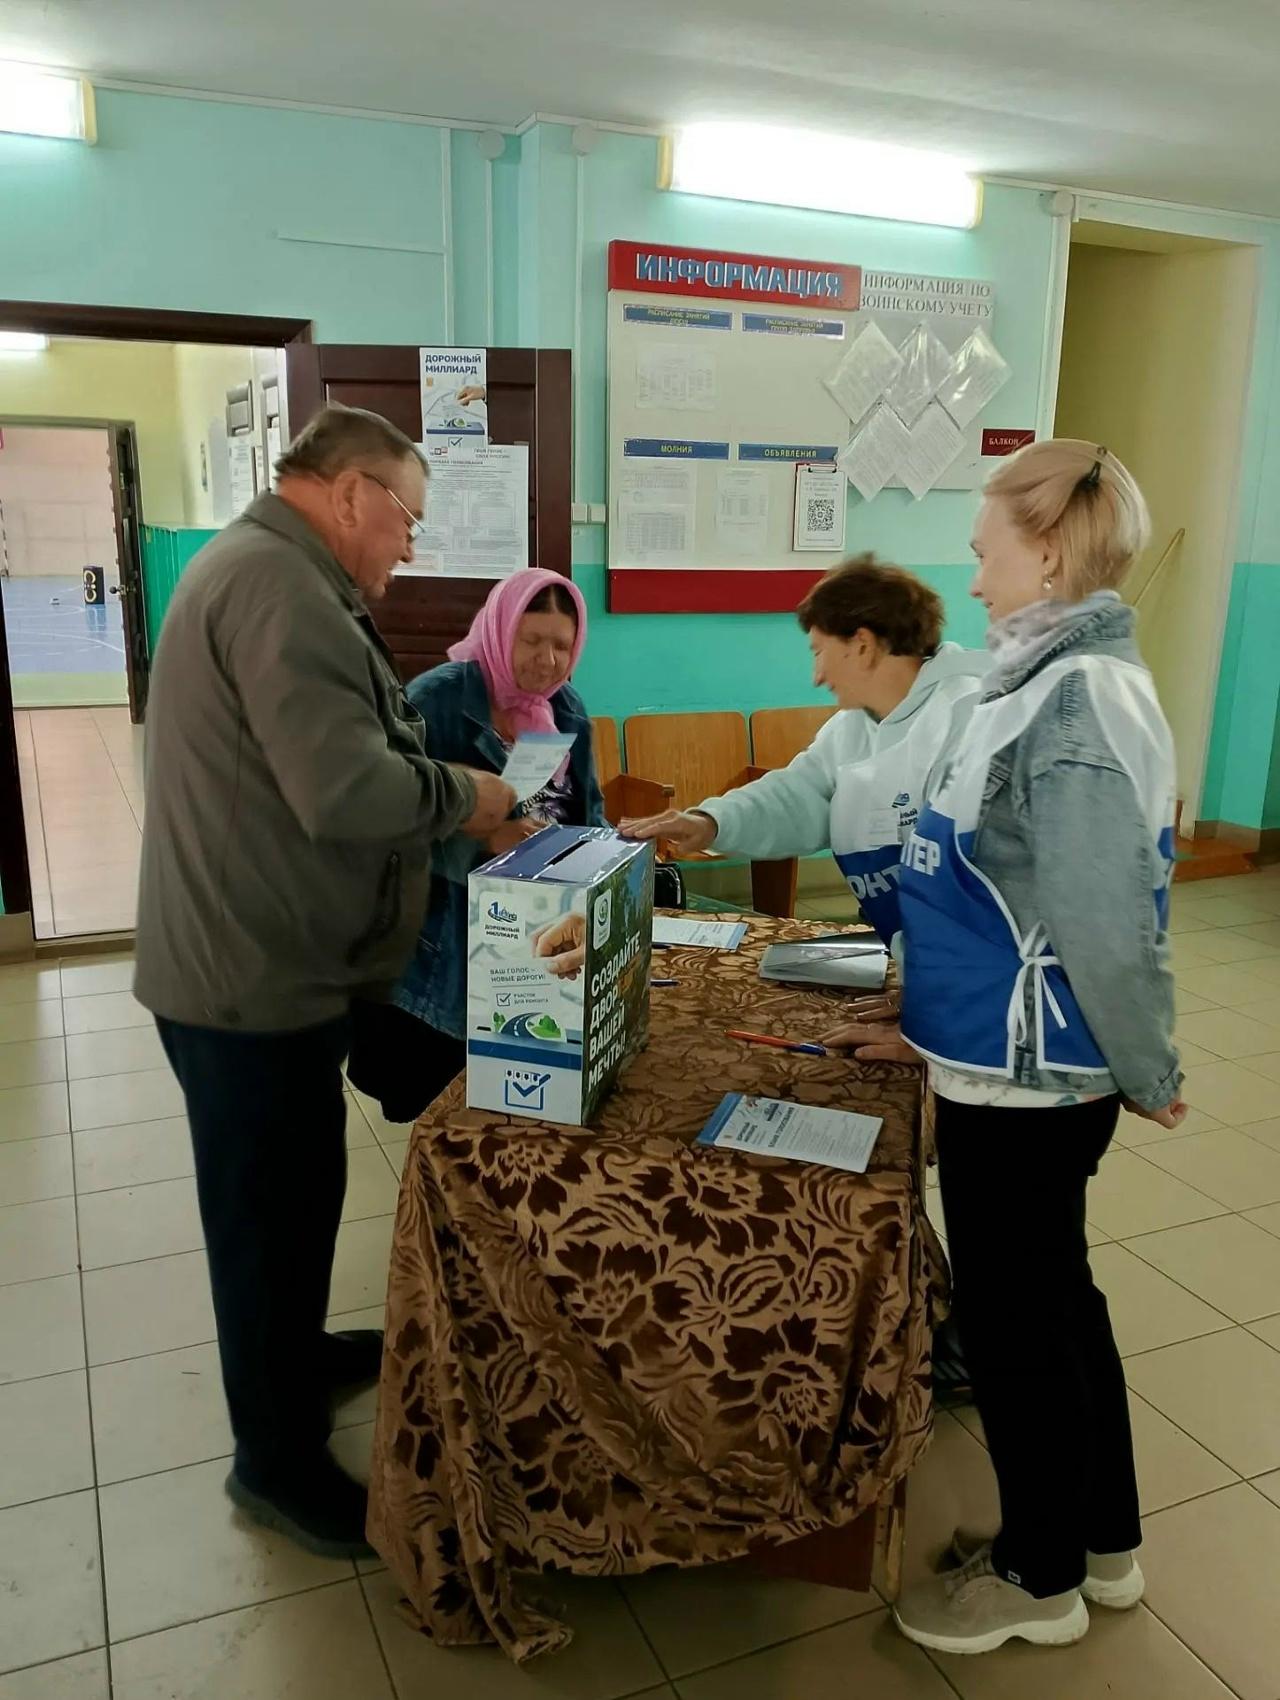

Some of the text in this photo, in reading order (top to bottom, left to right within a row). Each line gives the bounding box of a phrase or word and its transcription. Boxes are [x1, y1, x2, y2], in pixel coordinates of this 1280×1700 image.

[635, 253, 844, 297] ИНФОРМАЦИЯ
[864, 273, 991, 298] ИНФОРМАЦИЯ ПО
[950, 302, 993, 317] УЧЕТУ
[425, 354, 482, 364] ДОРОЖНЫЙ
[425, 365, 477, 375] МИЛЛИАРД
[989, 437, 1019, 446] БАЛКОН
[660, 444, 693, 454] МОЛНИЯ
[764, 449, 817, 459] ОБЪЯВЛЕНИЯ
[484, 924, 520, 933] ДОРОЖНЫЙ
[485, 930, 519, 940] МИЛЛИАРД
[591, 930, 641, 998] СОЗДАЙТЕ
[507, 967, 530, 975] ГОЛОС
[490, 975, 516, 983] НОВЫЕ
[590, 985, 618, 1034] ДВОР
[589, 999, 625, 1062] ВАШЕЙ
[588, 1030, 627, 1092] МЕЧТЫ!
